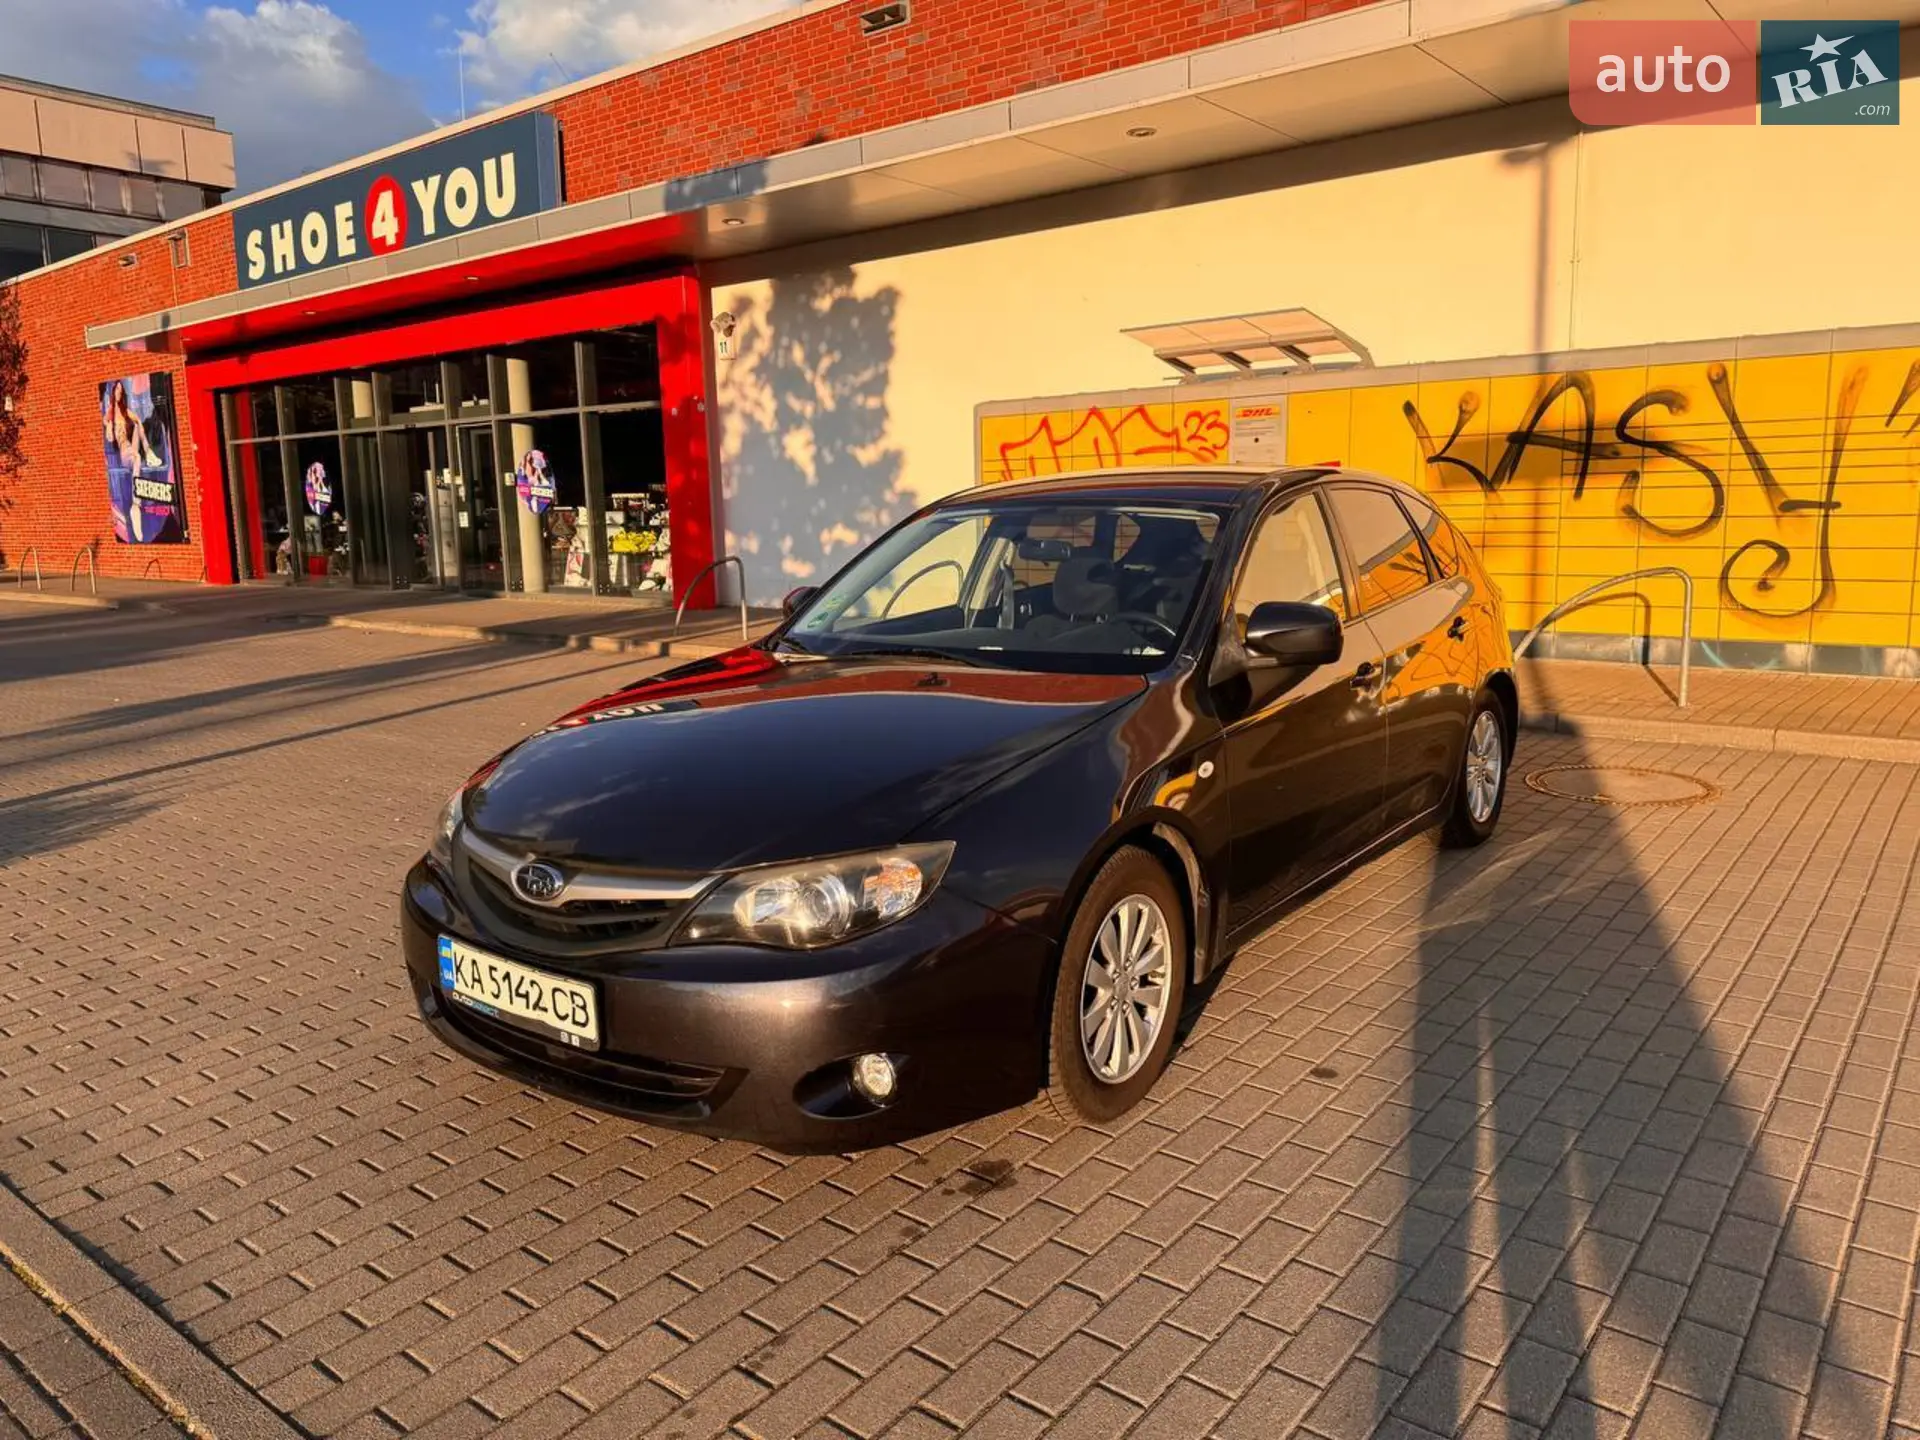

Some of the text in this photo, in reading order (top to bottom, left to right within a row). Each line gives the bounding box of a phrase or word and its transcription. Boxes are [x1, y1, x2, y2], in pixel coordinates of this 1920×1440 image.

[246, 152, 517, 281] SHOE 4 YOU
[453, 951, 485, 996] KA
[488, 965, 548, 1013] 5142
[551, 987, 590, 1028] CB
